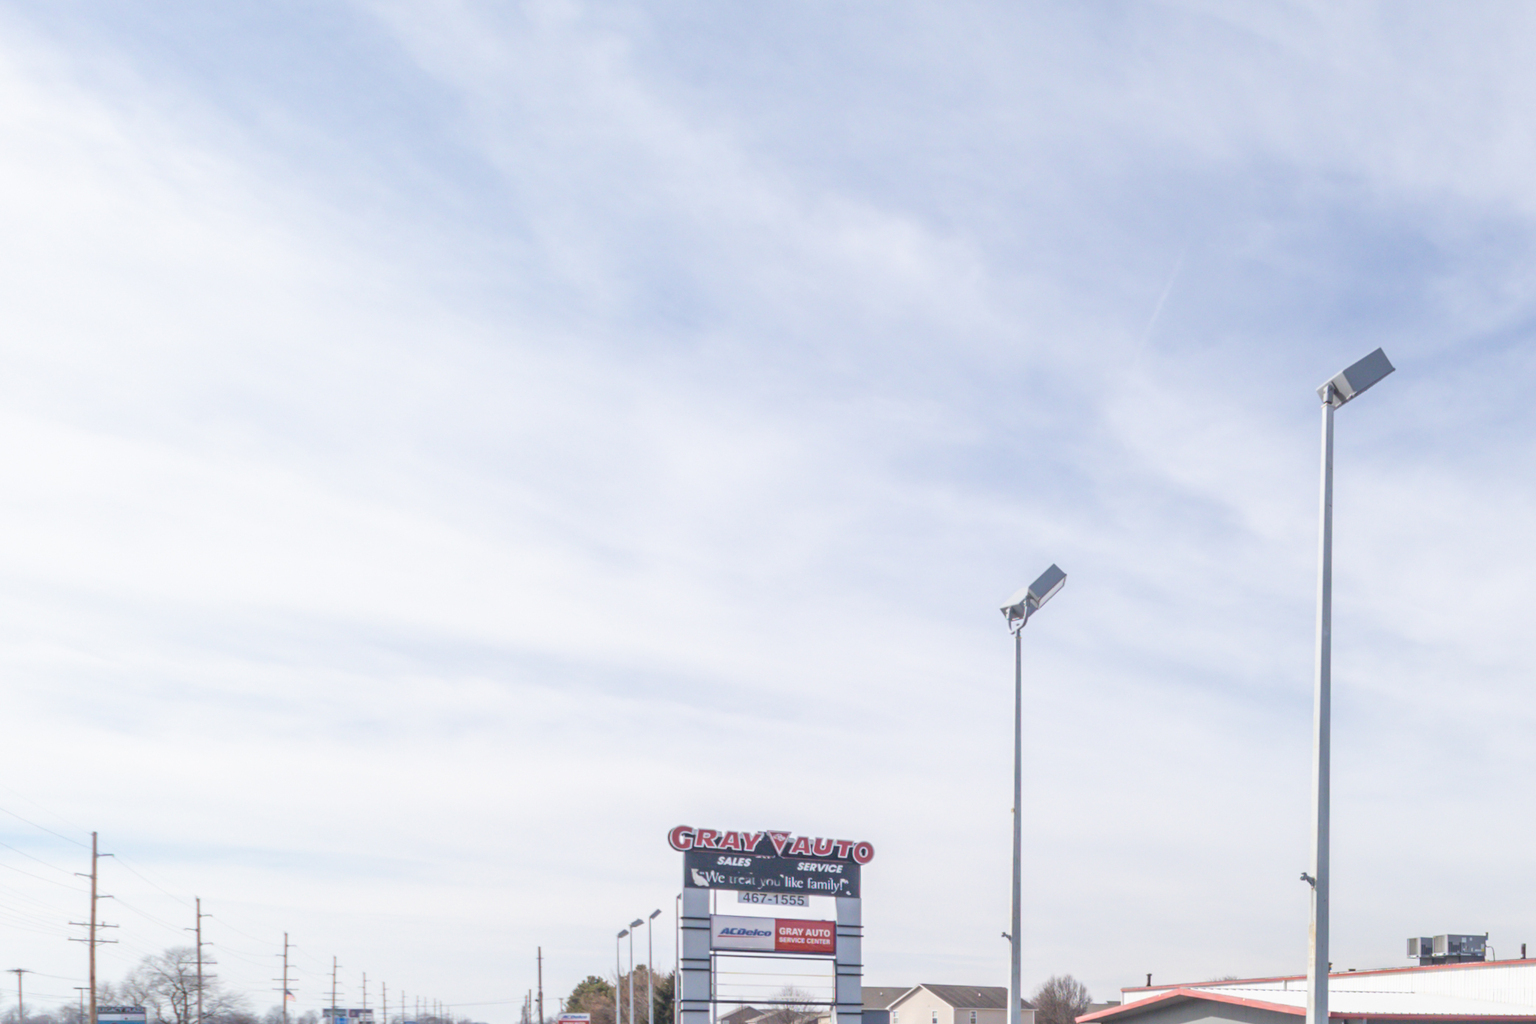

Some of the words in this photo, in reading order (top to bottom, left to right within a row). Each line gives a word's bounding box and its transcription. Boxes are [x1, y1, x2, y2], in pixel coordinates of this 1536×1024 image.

[668, 825, 765, 852] GRAY
[789, 836, 874, 864] AUTO
[717, 856, 752, 867] SALES
[797, 862, 843, 873] SERVICE
[760, 878, 780, 889] you
[785, 876, 804, 888] like
[743, 892, 805, 906] 467-1555
[720, 927, 772, 937] ACDelco
[779, 927, 804, 937] GRAY
[805, 928, 831, 937] AUTO
[806, 937, 831, 945] CENTER
